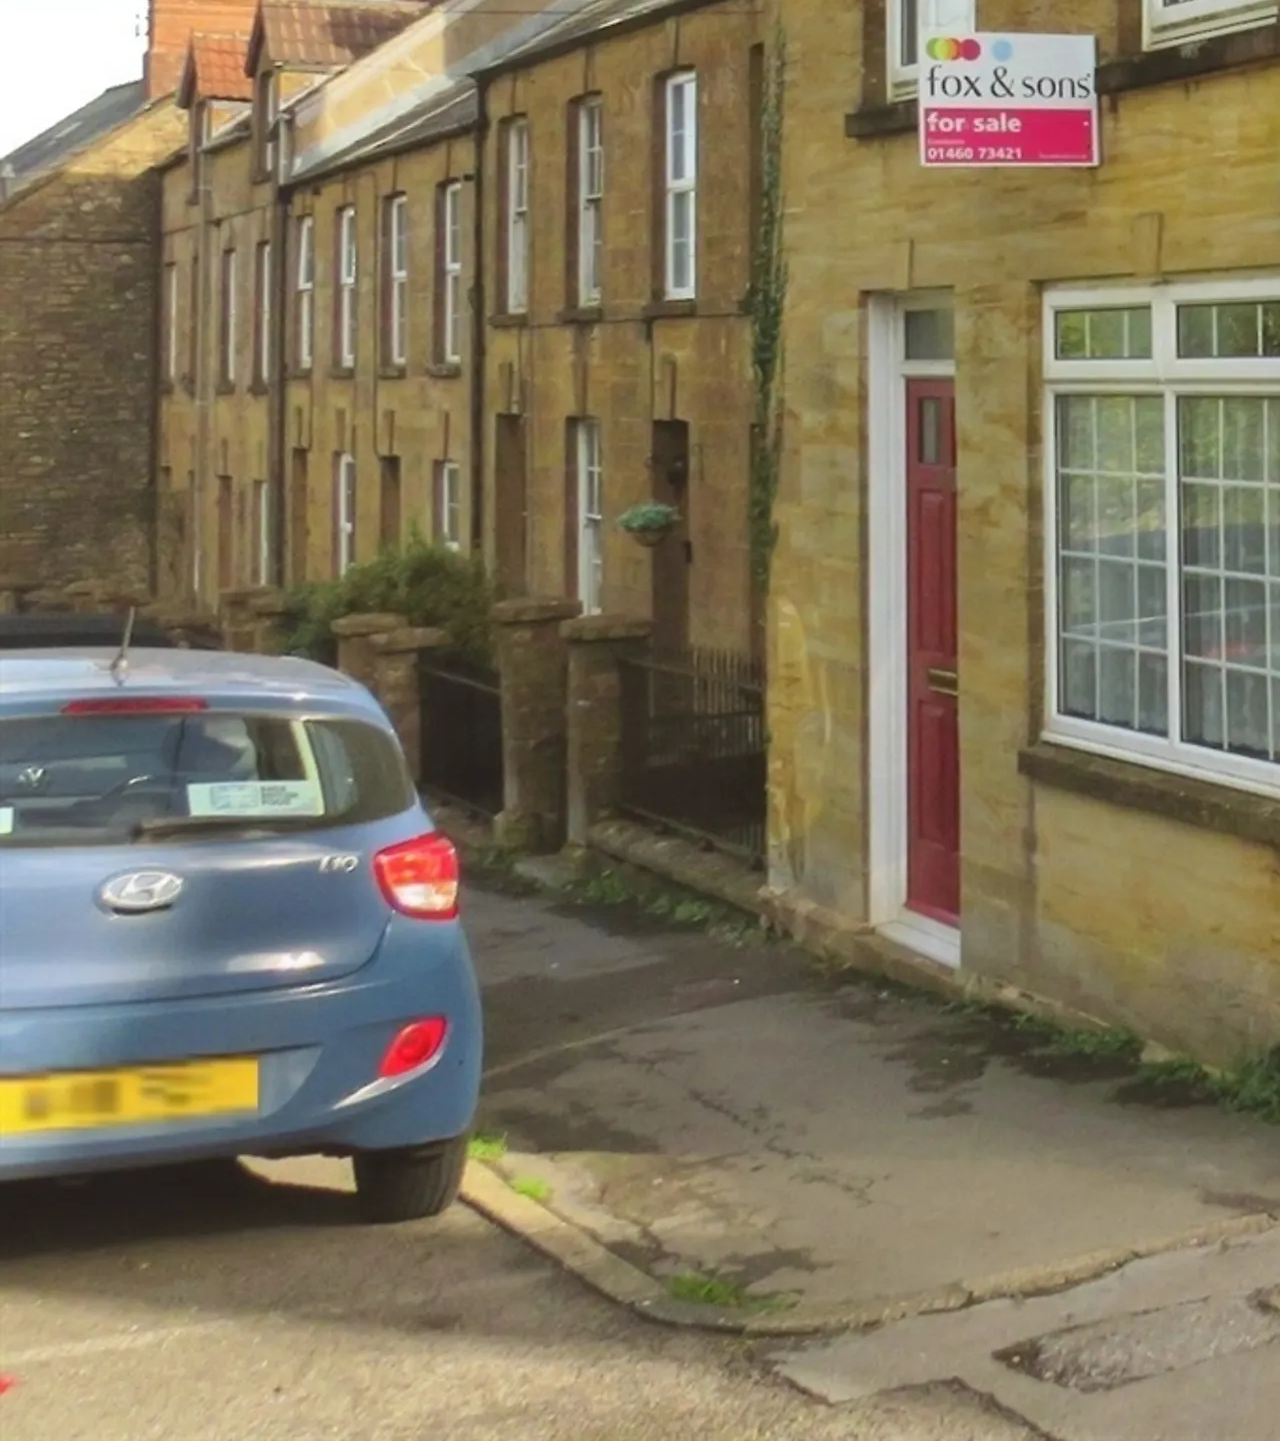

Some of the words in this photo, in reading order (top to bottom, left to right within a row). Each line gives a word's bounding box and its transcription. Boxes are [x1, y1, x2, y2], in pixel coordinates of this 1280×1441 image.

[926, 64, 983, 98] fox
[990, 65, 1015, 98] &
[1021, 75, 1091, 99] sons
[927, 111, 966, 133] for
[972, 111, 1022, 133] sale
[927, 146, 974, 160] 01460
[977, 146, 1022, 160] 73421
